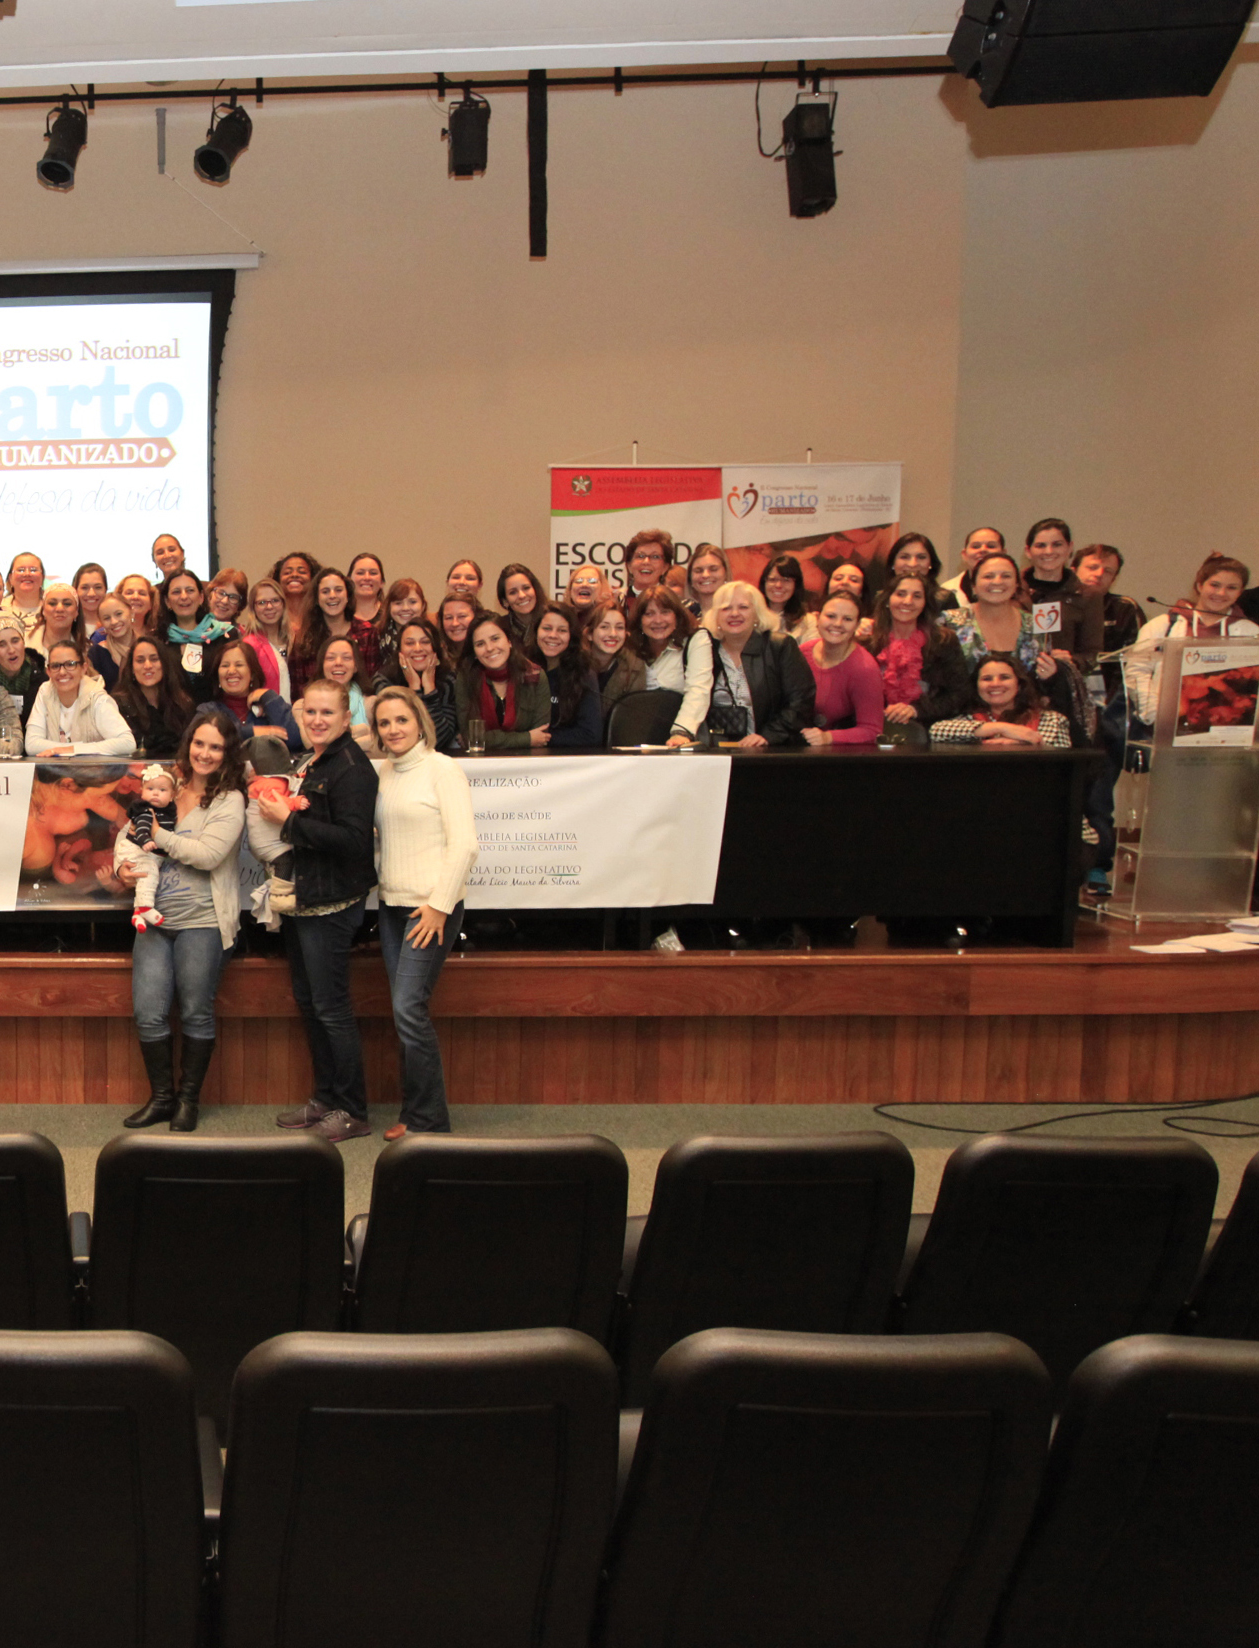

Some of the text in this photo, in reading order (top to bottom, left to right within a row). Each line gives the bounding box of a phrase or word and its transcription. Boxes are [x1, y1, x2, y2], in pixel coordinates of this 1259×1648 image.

[79, 338, 180, 361] Nacional
[80, 480, 117, 512] da
[124, 478, 181, 511] vida
[761, 491, 819, 511] parto
[555, 542, 627, 566] ESCO
[474, 811, 499, 820] SSÃO
[517, 810, 552, 820] SAÚDE
[515, 833, 578, 841] LEGISLATIVA
[470, 865, 581, 874] OLA DO LEGISLATIVO
[539, 876, 547, 885] da
